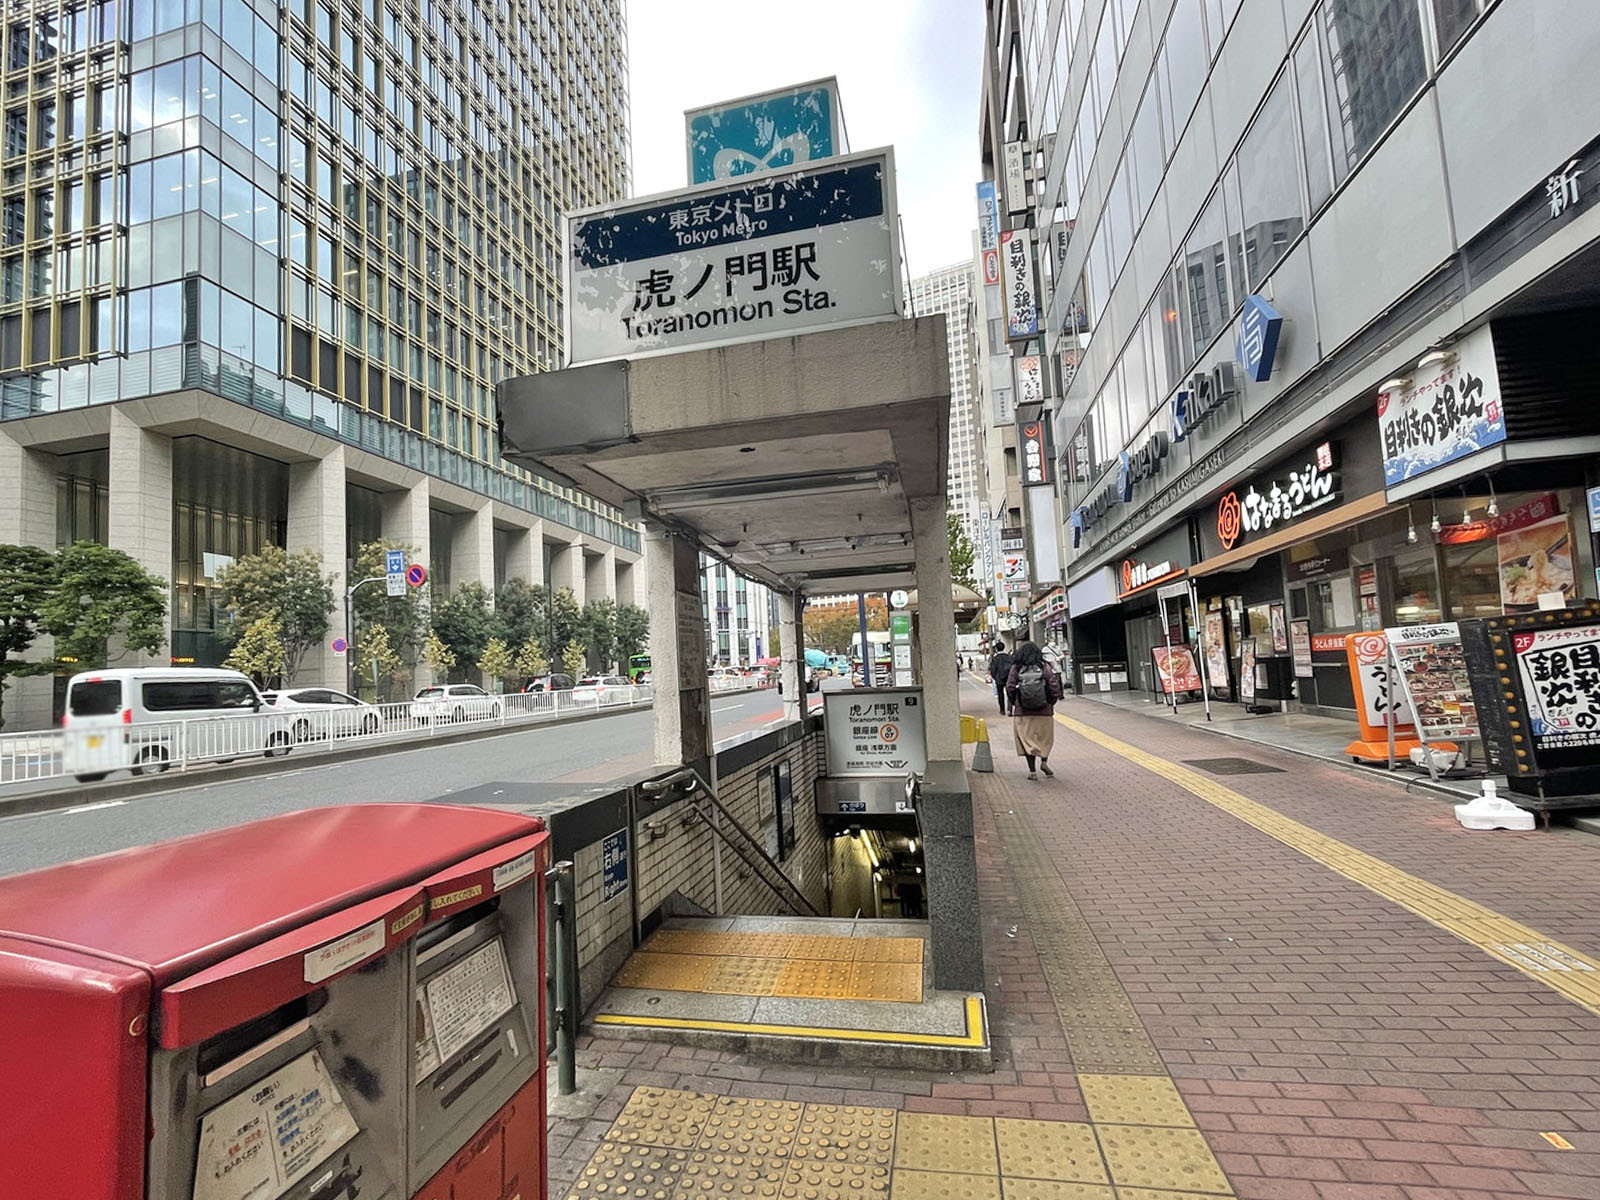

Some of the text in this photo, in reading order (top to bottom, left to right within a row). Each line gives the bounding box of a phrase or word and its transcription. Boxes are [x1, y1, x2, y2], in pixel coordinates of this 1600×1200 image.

[668, 192, 774, 231] 東京メトロ
[1545, 160, 1584, 218] 新
[675, 218, 768, 246] Tokyo Metro
[632, 242, 821, 313] 虎ノ門駅
[622, 289, 837, 340] Toranomon Sta.
[1385, 371, 1484, 460] 目利きの銀次
[1241, 463, 1333, 532] はなまるうどん
[1514, 637, 1531, 649] 2F
[1538, 627, 1600, 642] ランチやってま
[1530, 650, 1578, 709] 銀次
[849, 703, 900, 717] 虎ノ門駅
